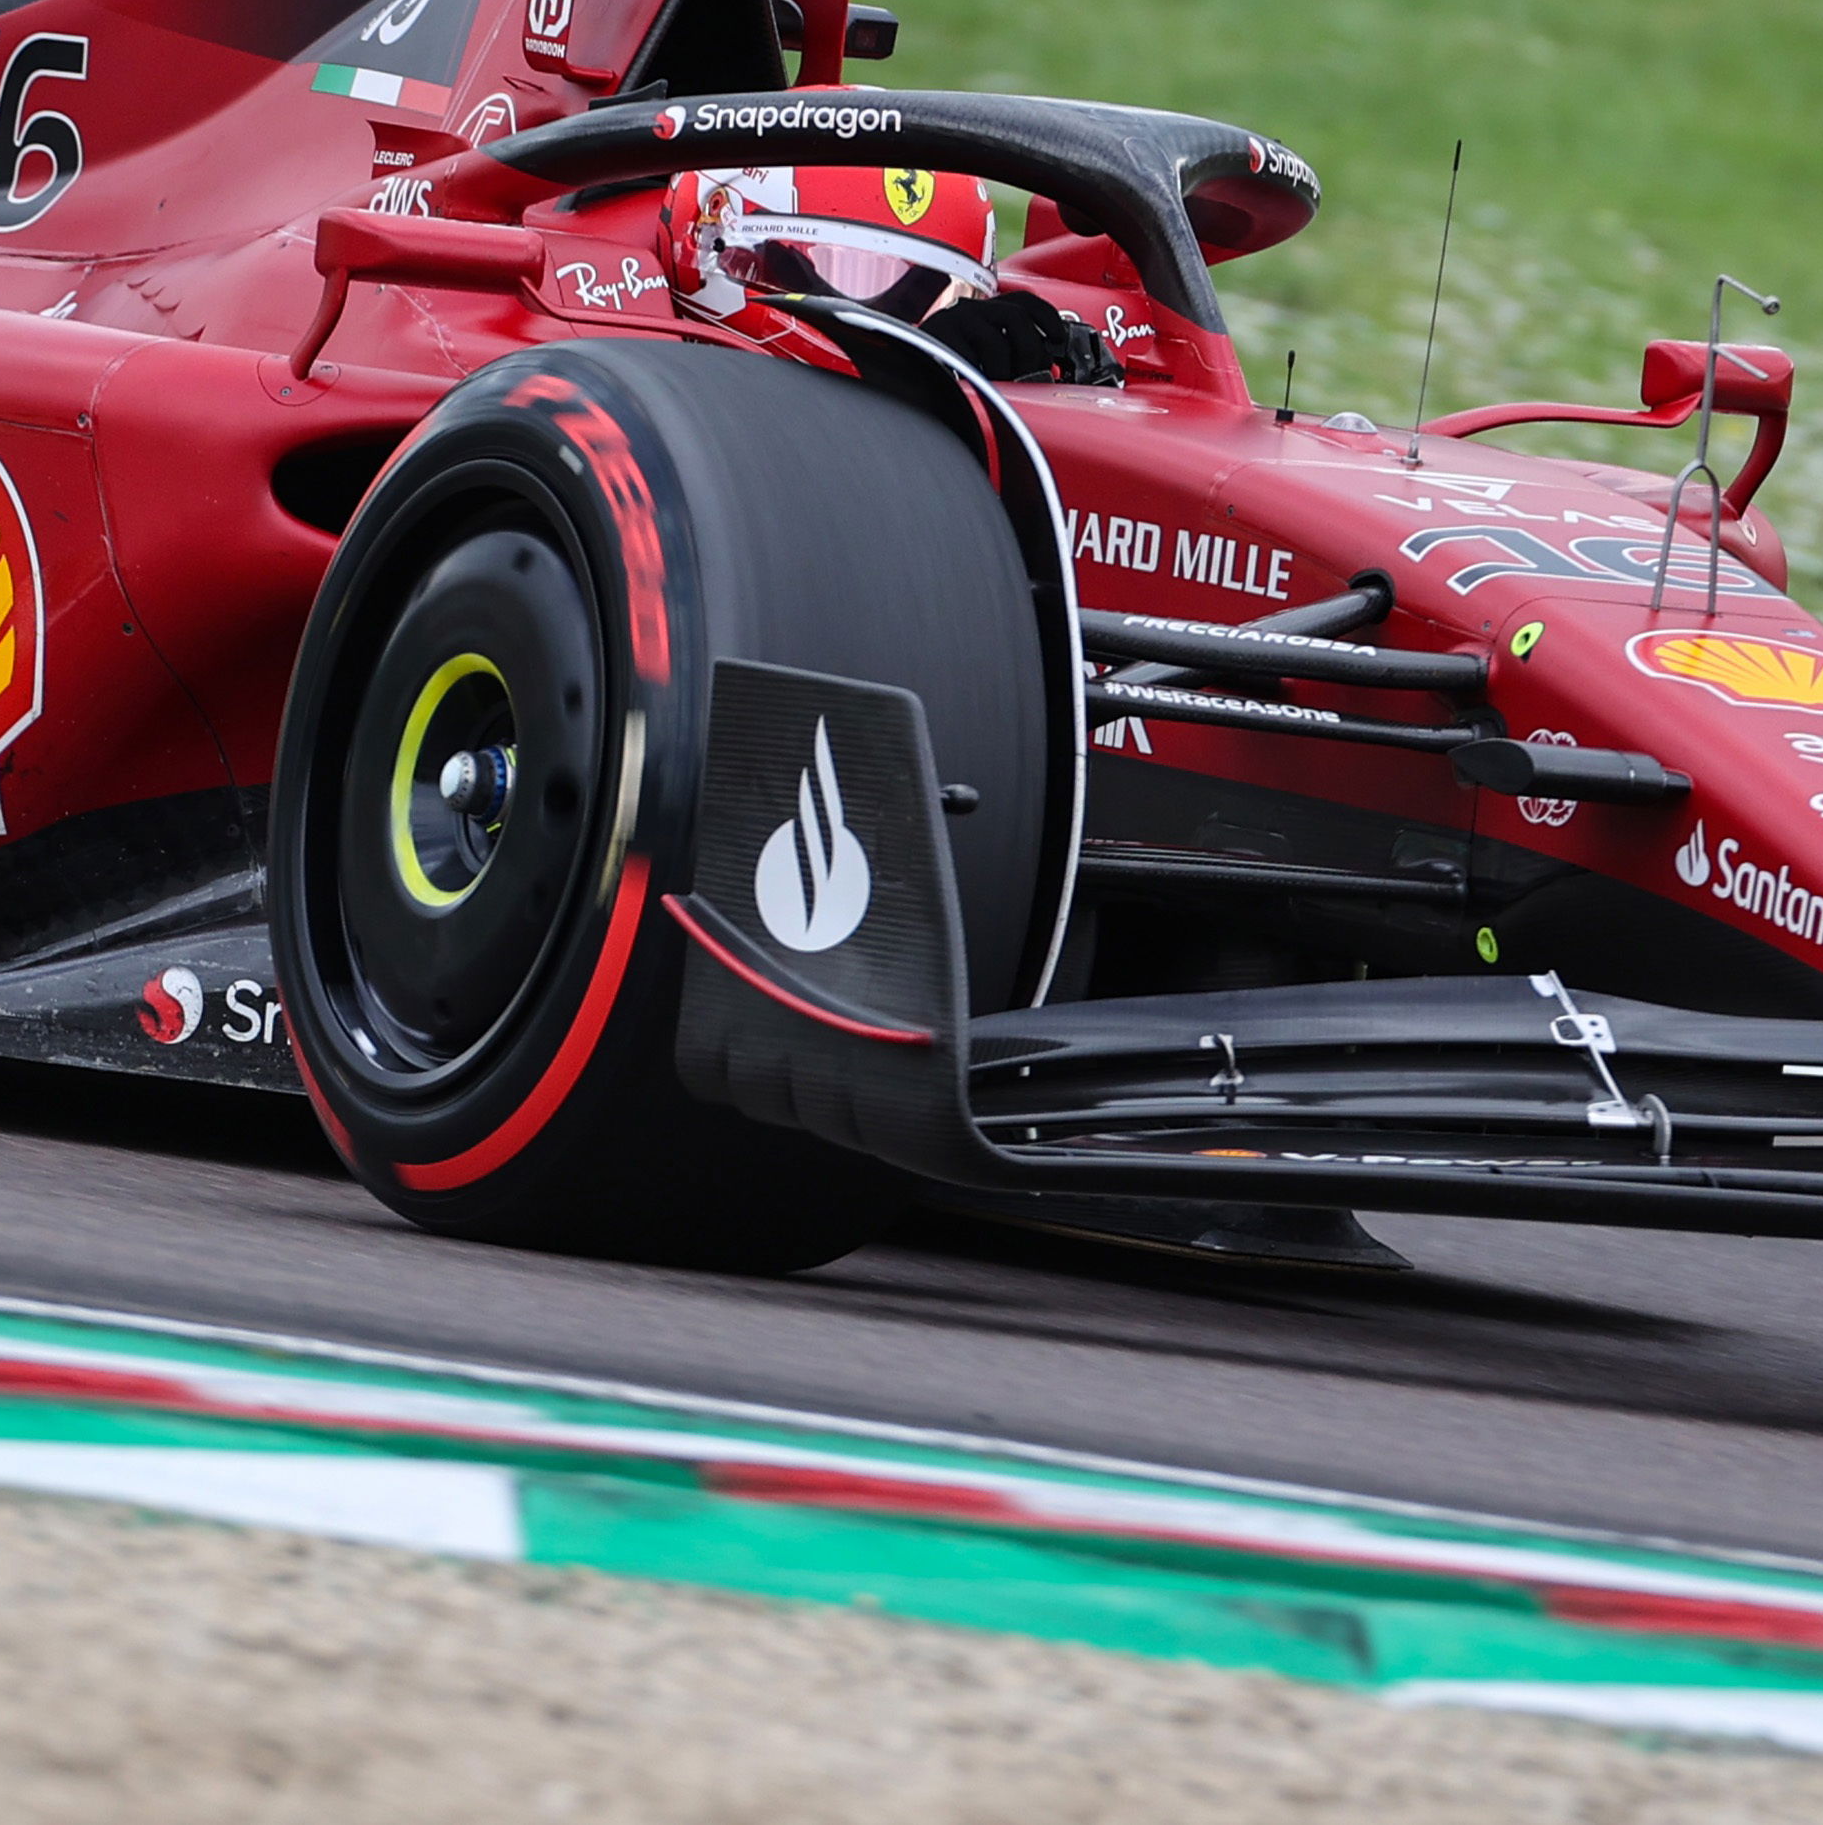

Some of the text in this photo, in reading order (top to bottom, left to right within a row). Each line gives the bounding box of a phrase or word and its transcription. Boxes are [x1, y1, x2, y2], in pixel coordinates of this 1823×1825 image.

[694, 100, 902, 139] Snapdragon
[373, 150, 415, 167] LECLERC
[741, 225, 819, 236] RICHARD MILLE
[1172, 529, 1294, 601] MILLE
[1123, 616, 1377, 657] FRECCIAROSSA
